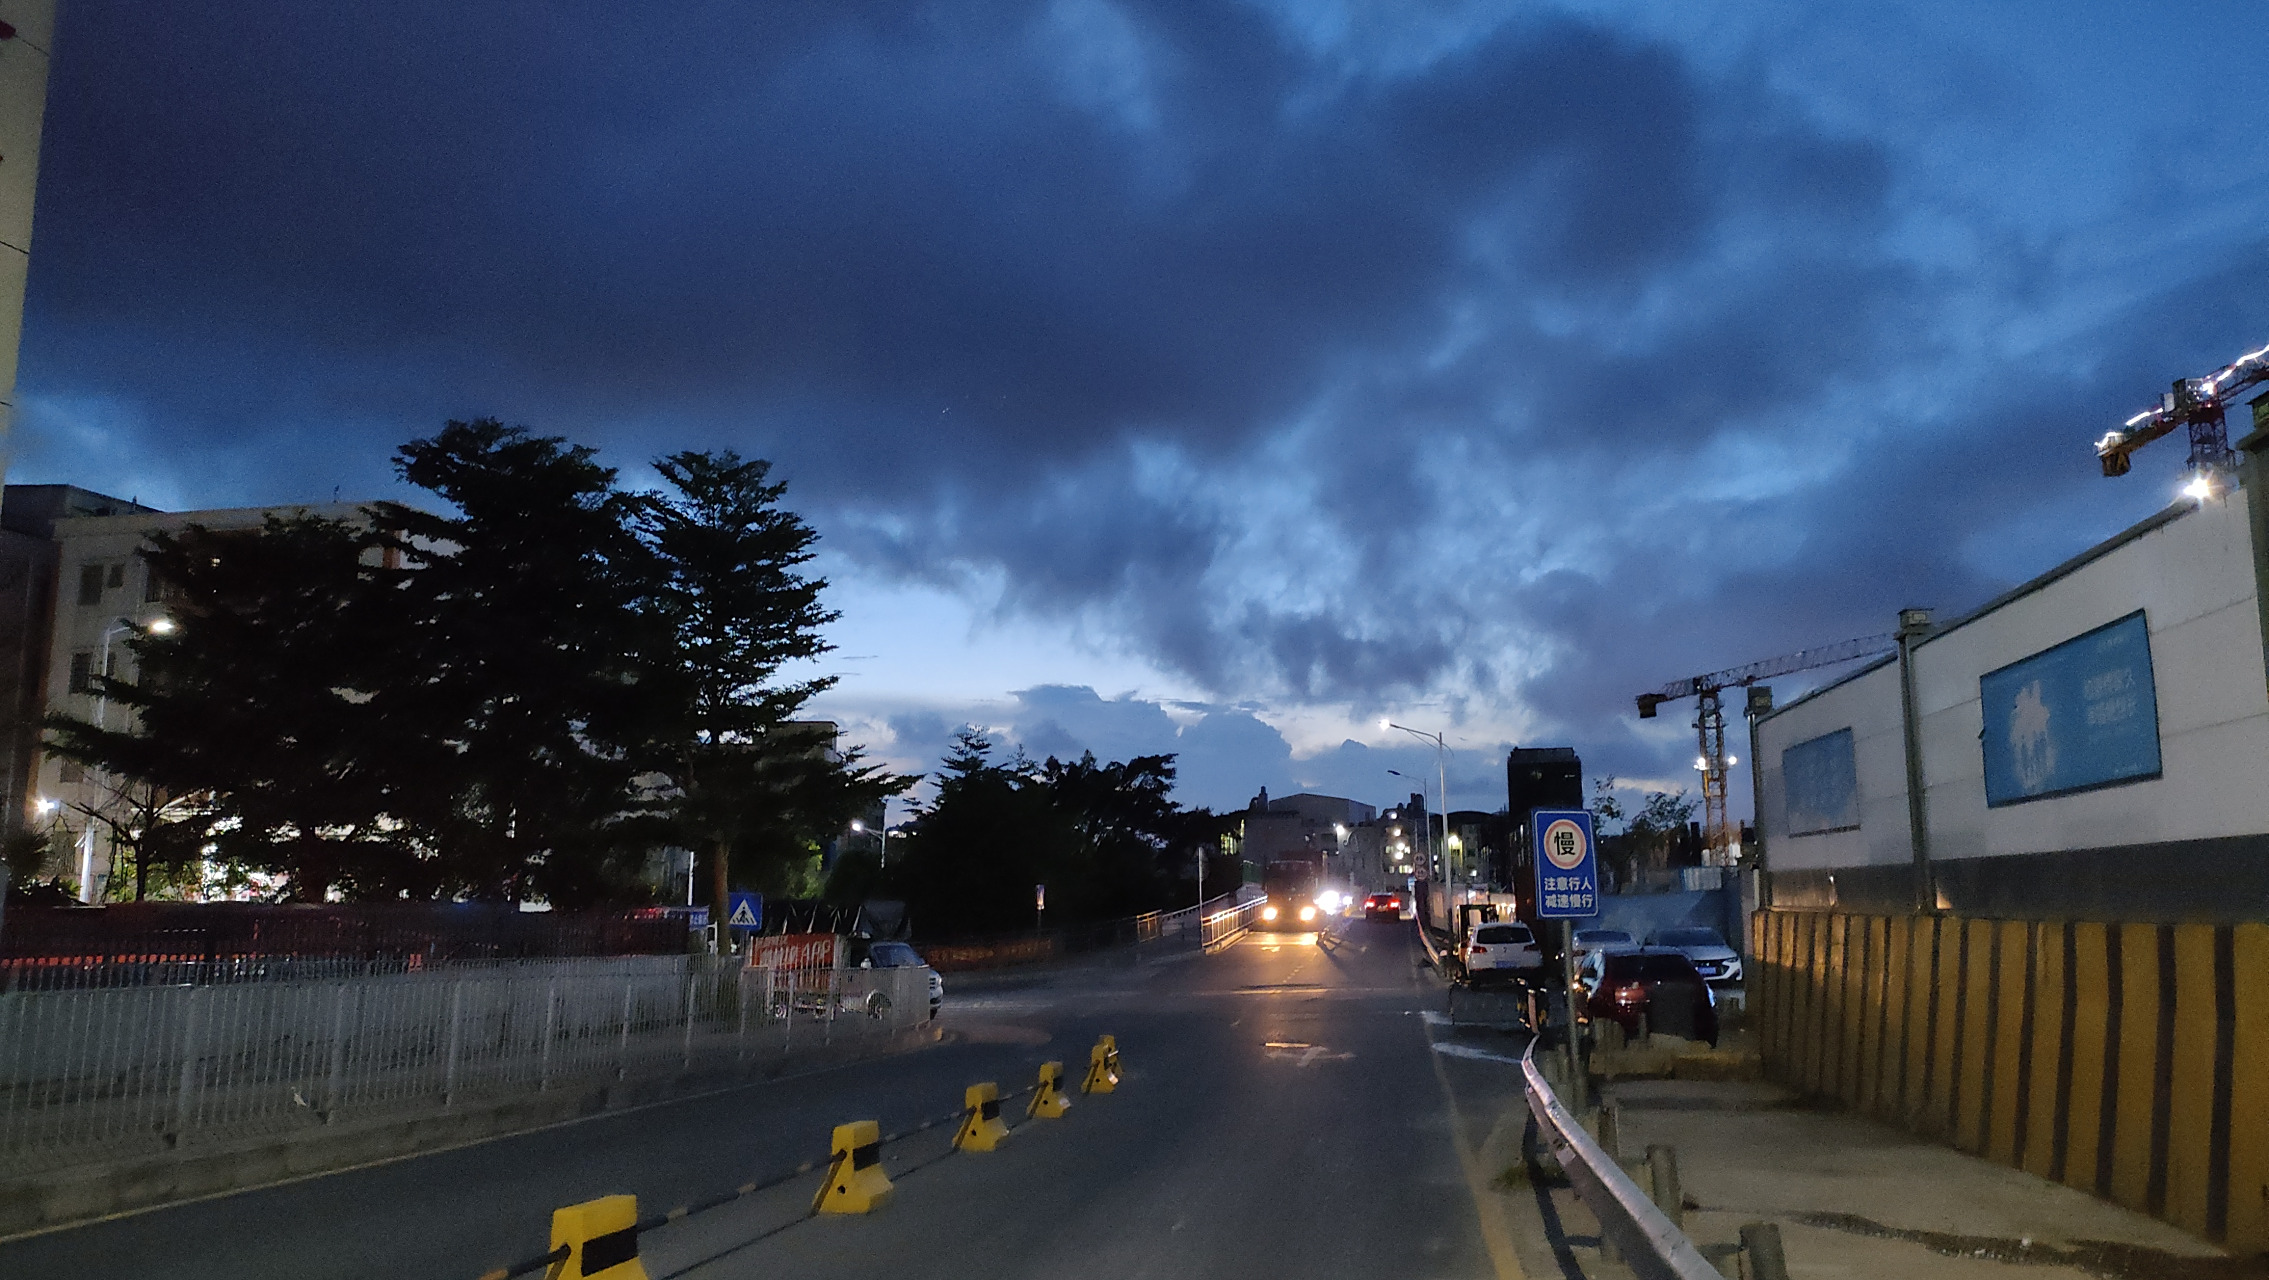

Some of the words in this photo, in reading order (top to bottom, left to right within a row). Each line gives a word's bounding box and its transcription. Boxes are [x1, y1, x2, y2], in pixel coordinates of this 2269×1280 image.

[1554, 831, 1576, 856] 慢
[1544, 876, 1592, 892] 注意行人
[1545, 893, 1593, 909] 减速慢行
